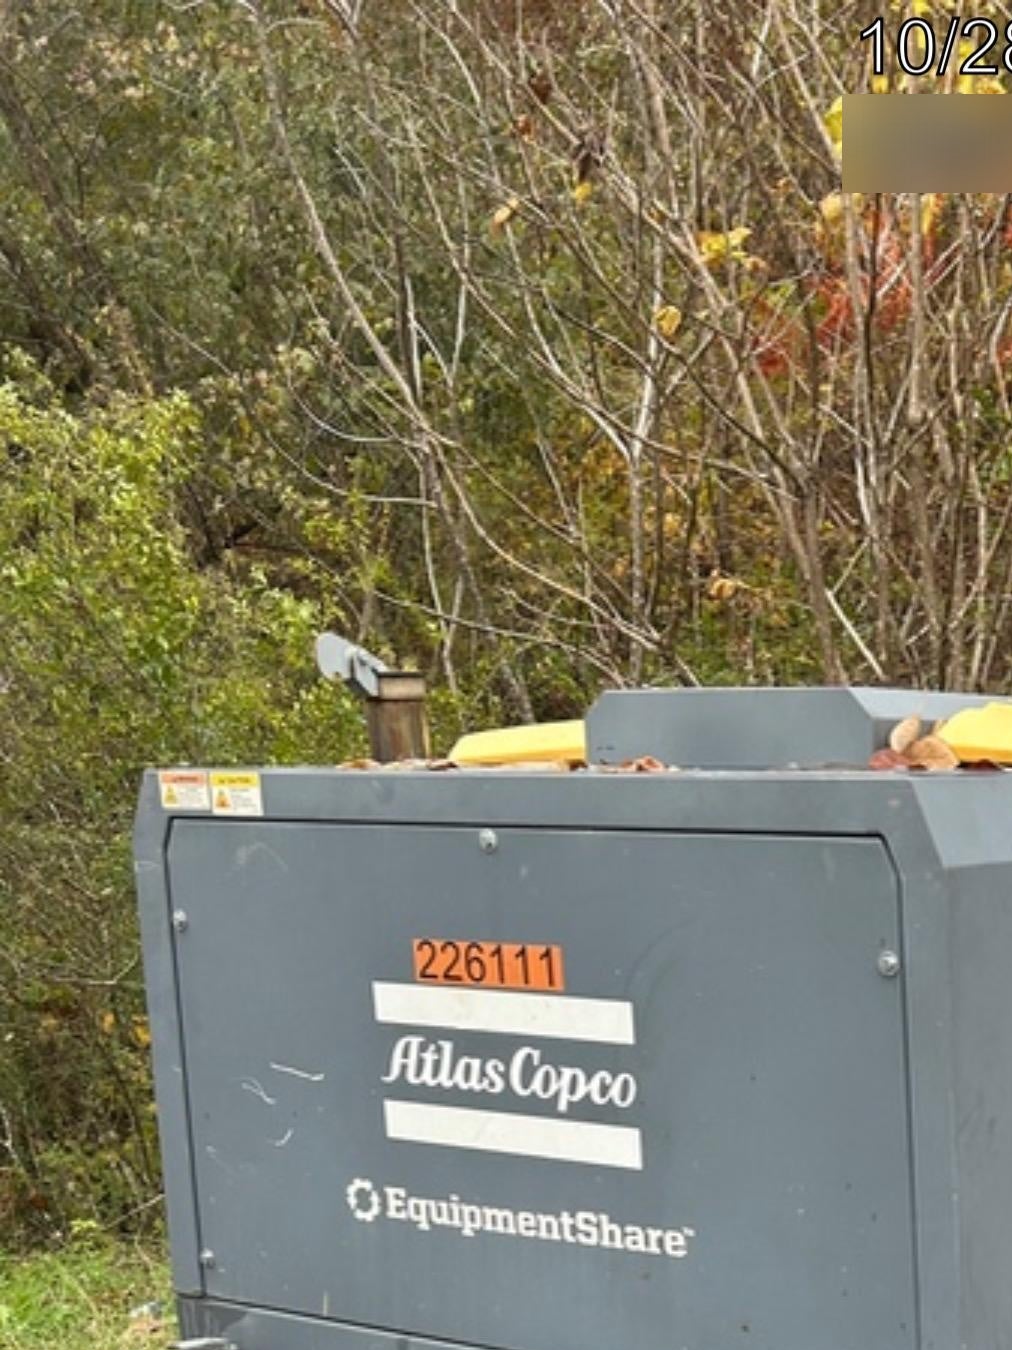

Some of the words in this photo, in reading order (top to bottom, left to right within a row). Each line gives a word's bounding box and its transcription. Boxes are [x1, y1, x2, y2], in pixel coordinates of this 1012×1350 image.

[415, 940, 557, 987] 226111
[381, 1034, 504, 1094] Atlas
[508, 1046, 637, 1112] Copco
